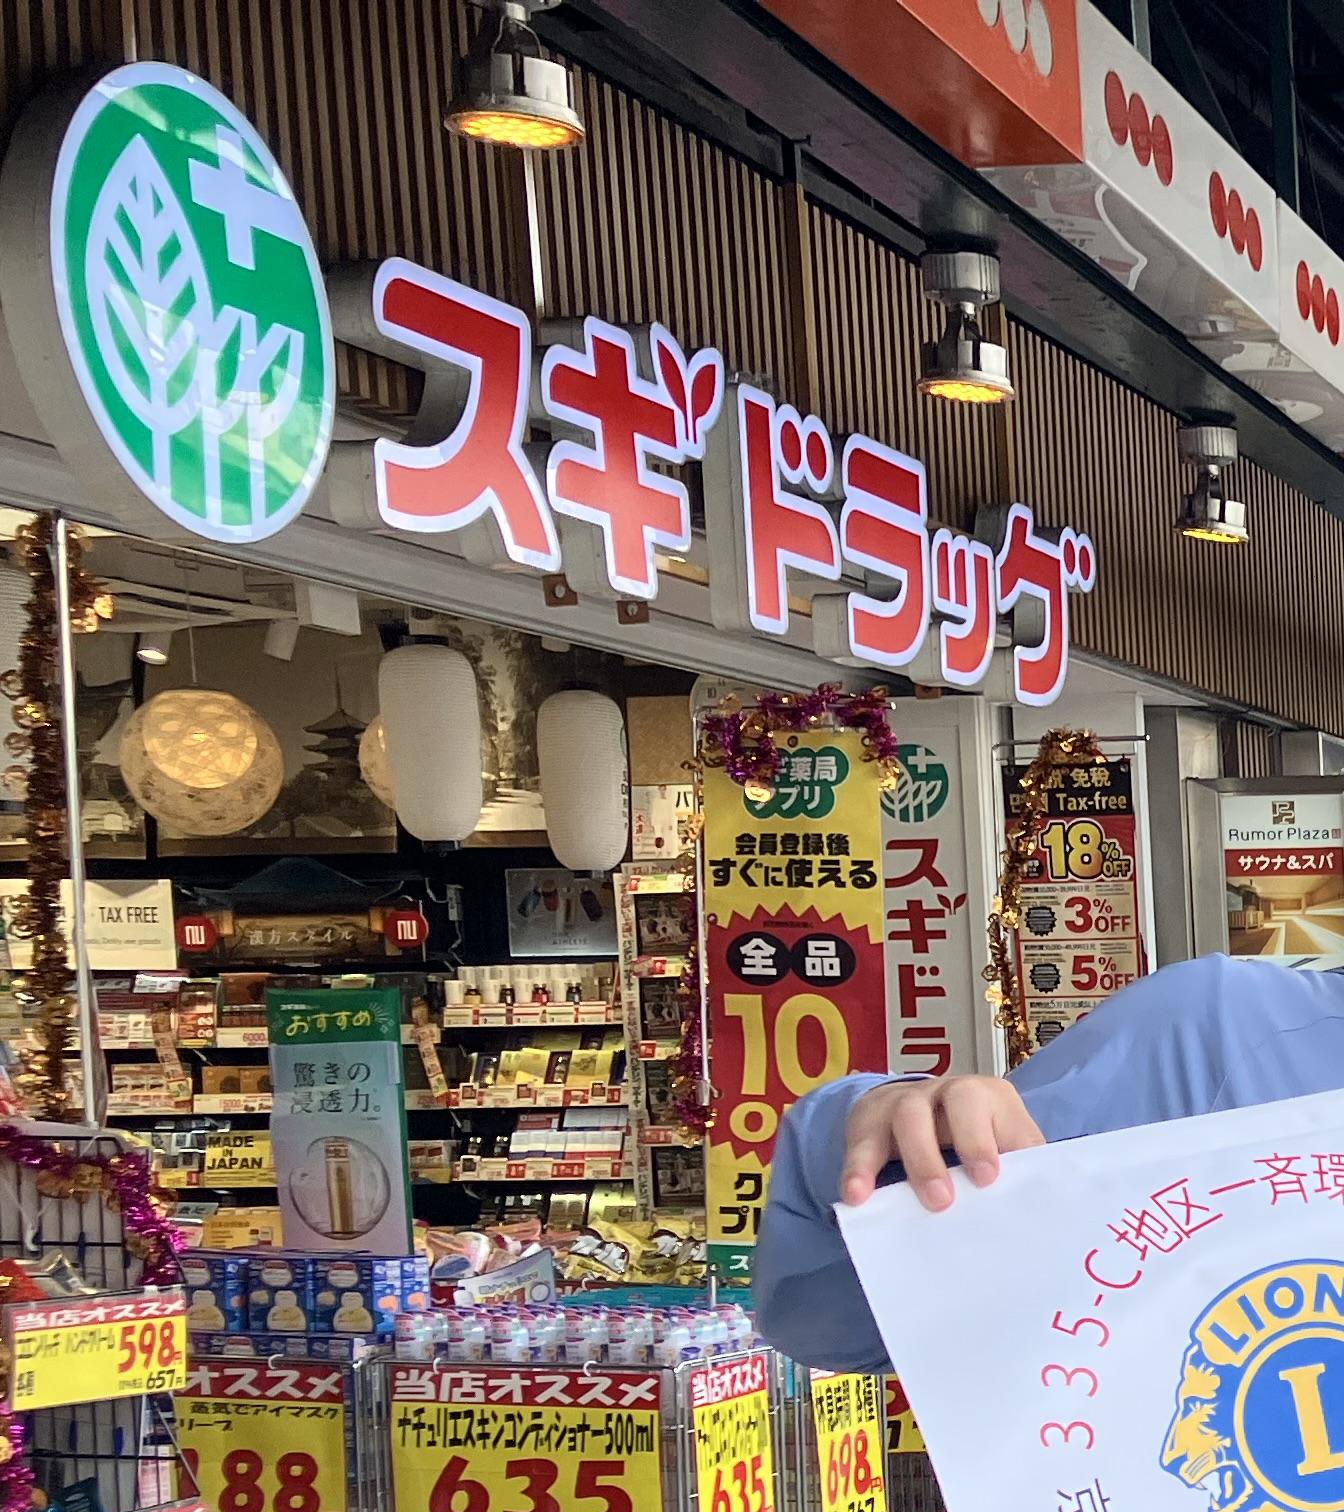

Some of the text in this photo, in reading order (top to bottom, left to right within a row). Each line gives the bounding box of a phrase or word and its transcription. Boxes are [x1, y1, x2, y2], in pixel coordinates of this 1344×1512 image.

[372, 256, 1096, 707] スギドラッグ
[1056, 793, 1128, 811] Tax-free
[735, 833, 850, 856] 会員登録後
[1228, 827, 1330, 842] Rumor Plaza
[1102, 857, 1132, 878] OFF
[1238, 852, 1334, 872] サウナ&スパ
[709, 858, 878, 889] すぐに使える
[98, 906, 159, 924] TAX FREE
[1094, 915, 1131, 933] OFF
[285, 1010, 371, 1036] おすすめ
[293, 1062, 371, 1088] 驚きの
[208, 1135, 254, 1148] MADE
[207, 1157, 263, 1170] JAPAN
[222, 1149, 233, 1158] IN
[15, 1300, 185, 1329] 当店オススメ
[392, 1369, 660, 1407] 当店オススメ
[692, 1360, 764, 1406] 当店オススメ
